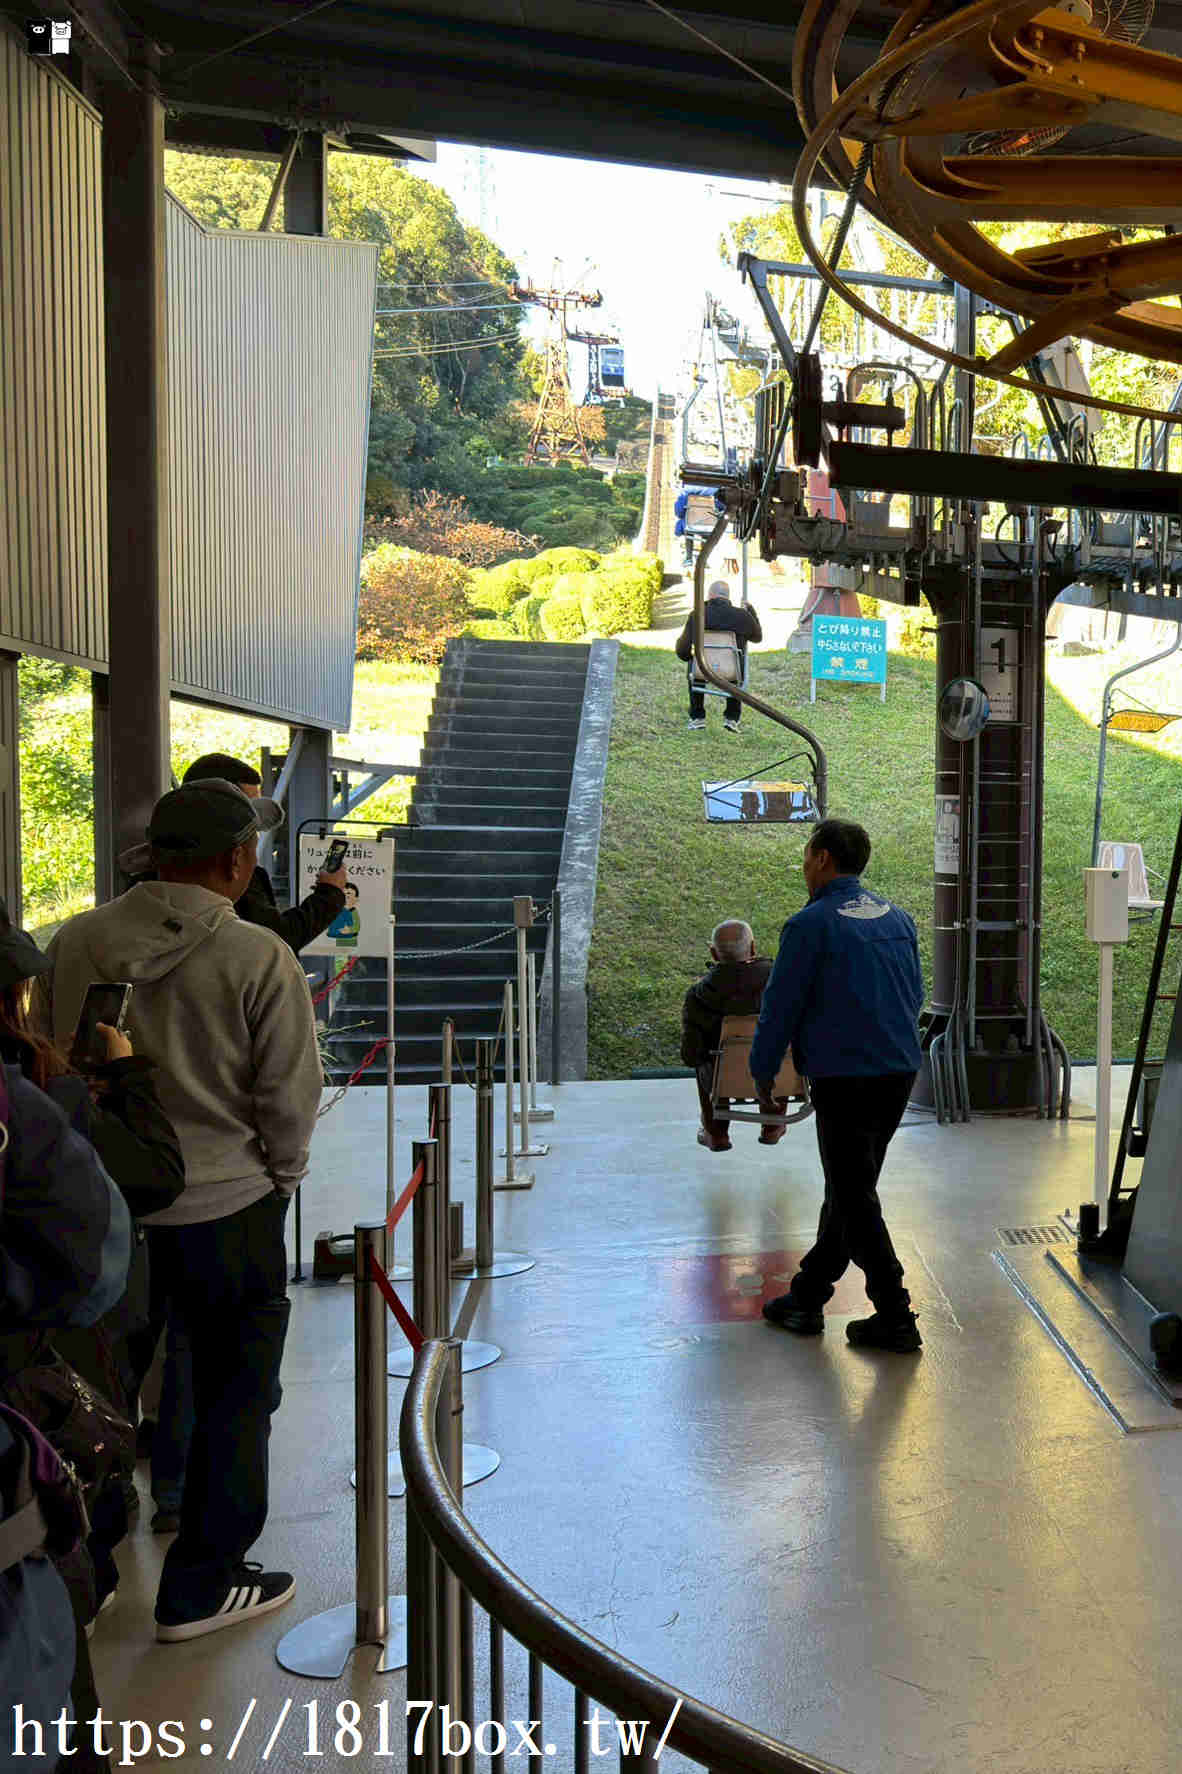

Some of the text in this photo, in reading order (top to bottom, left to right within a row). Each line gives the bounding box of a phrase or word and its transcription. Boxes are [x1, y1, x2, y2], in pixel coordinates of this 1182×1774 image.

[818, 623, 881, 638] とび降り禁止
[990, 637, 1005, 673] 1
